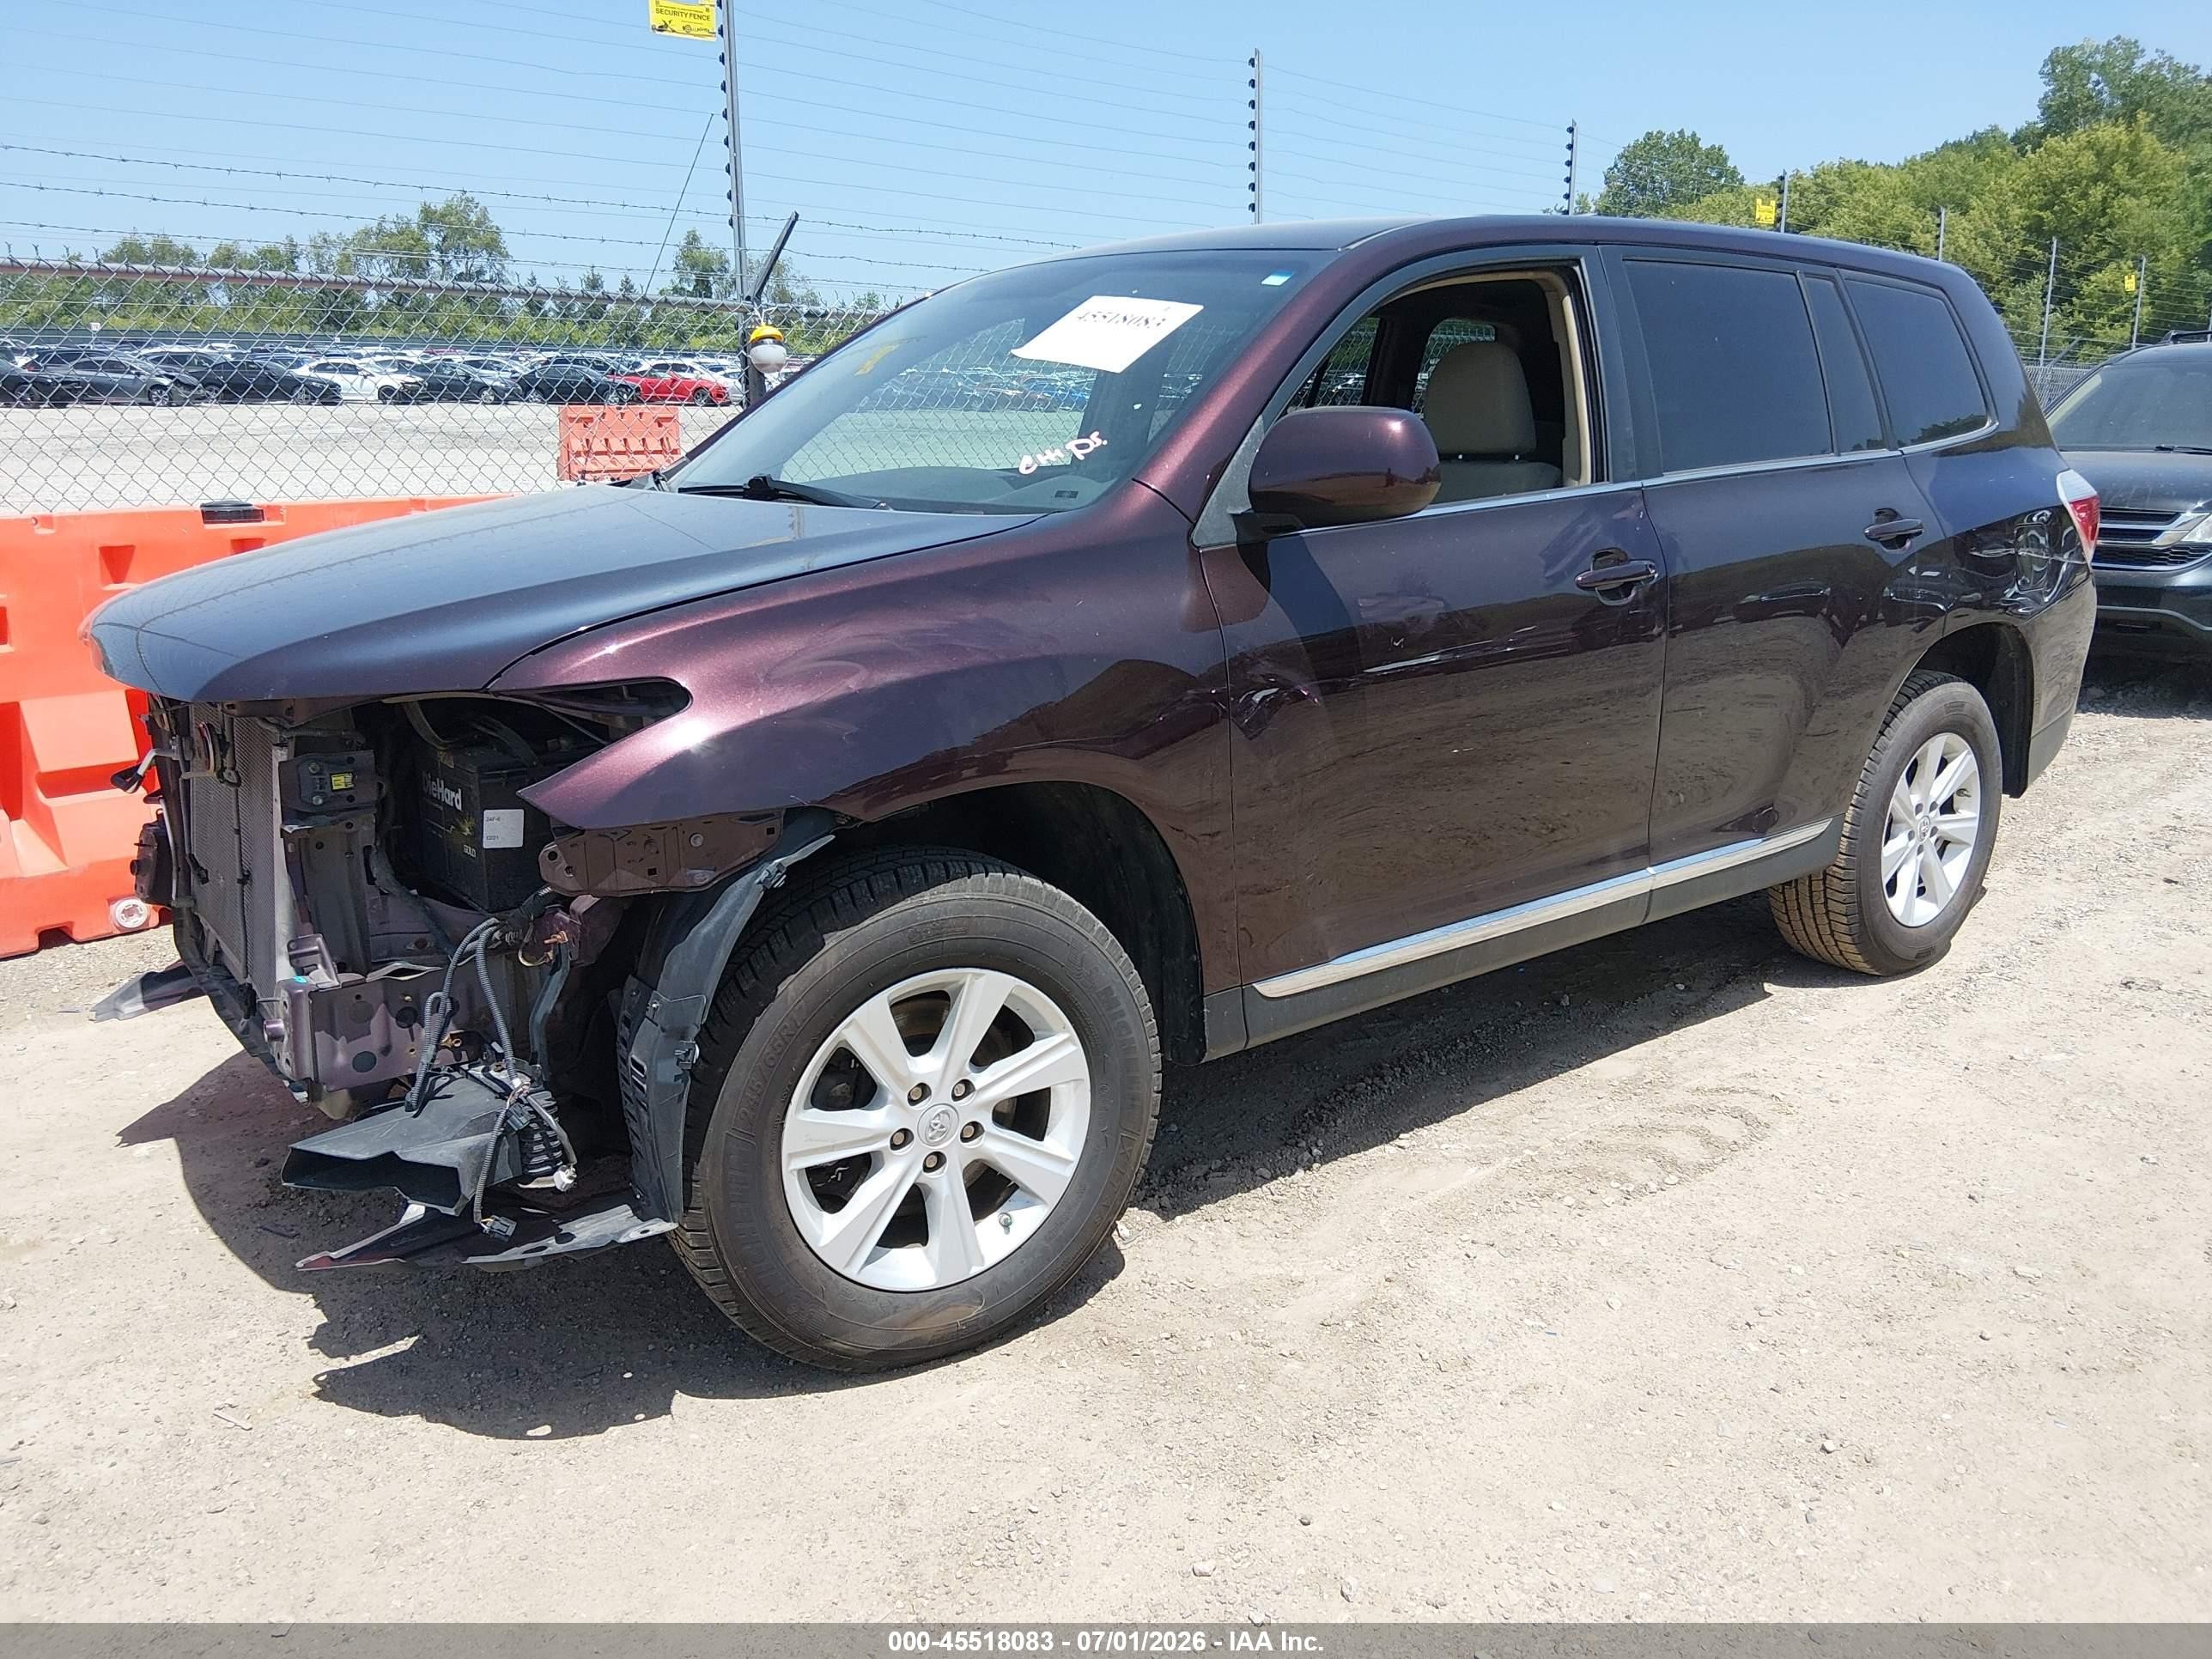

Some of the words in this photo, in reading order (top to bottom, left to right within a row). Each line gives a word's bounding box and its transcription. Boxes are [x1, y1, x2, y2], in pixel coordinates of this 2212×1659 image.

[655, 8, 689, 18] SECURITY
[690, 13, 711, 21] FENCE
[422, 771, 463, 811] DieHard
[463, 844, 477, 858] GOLD
